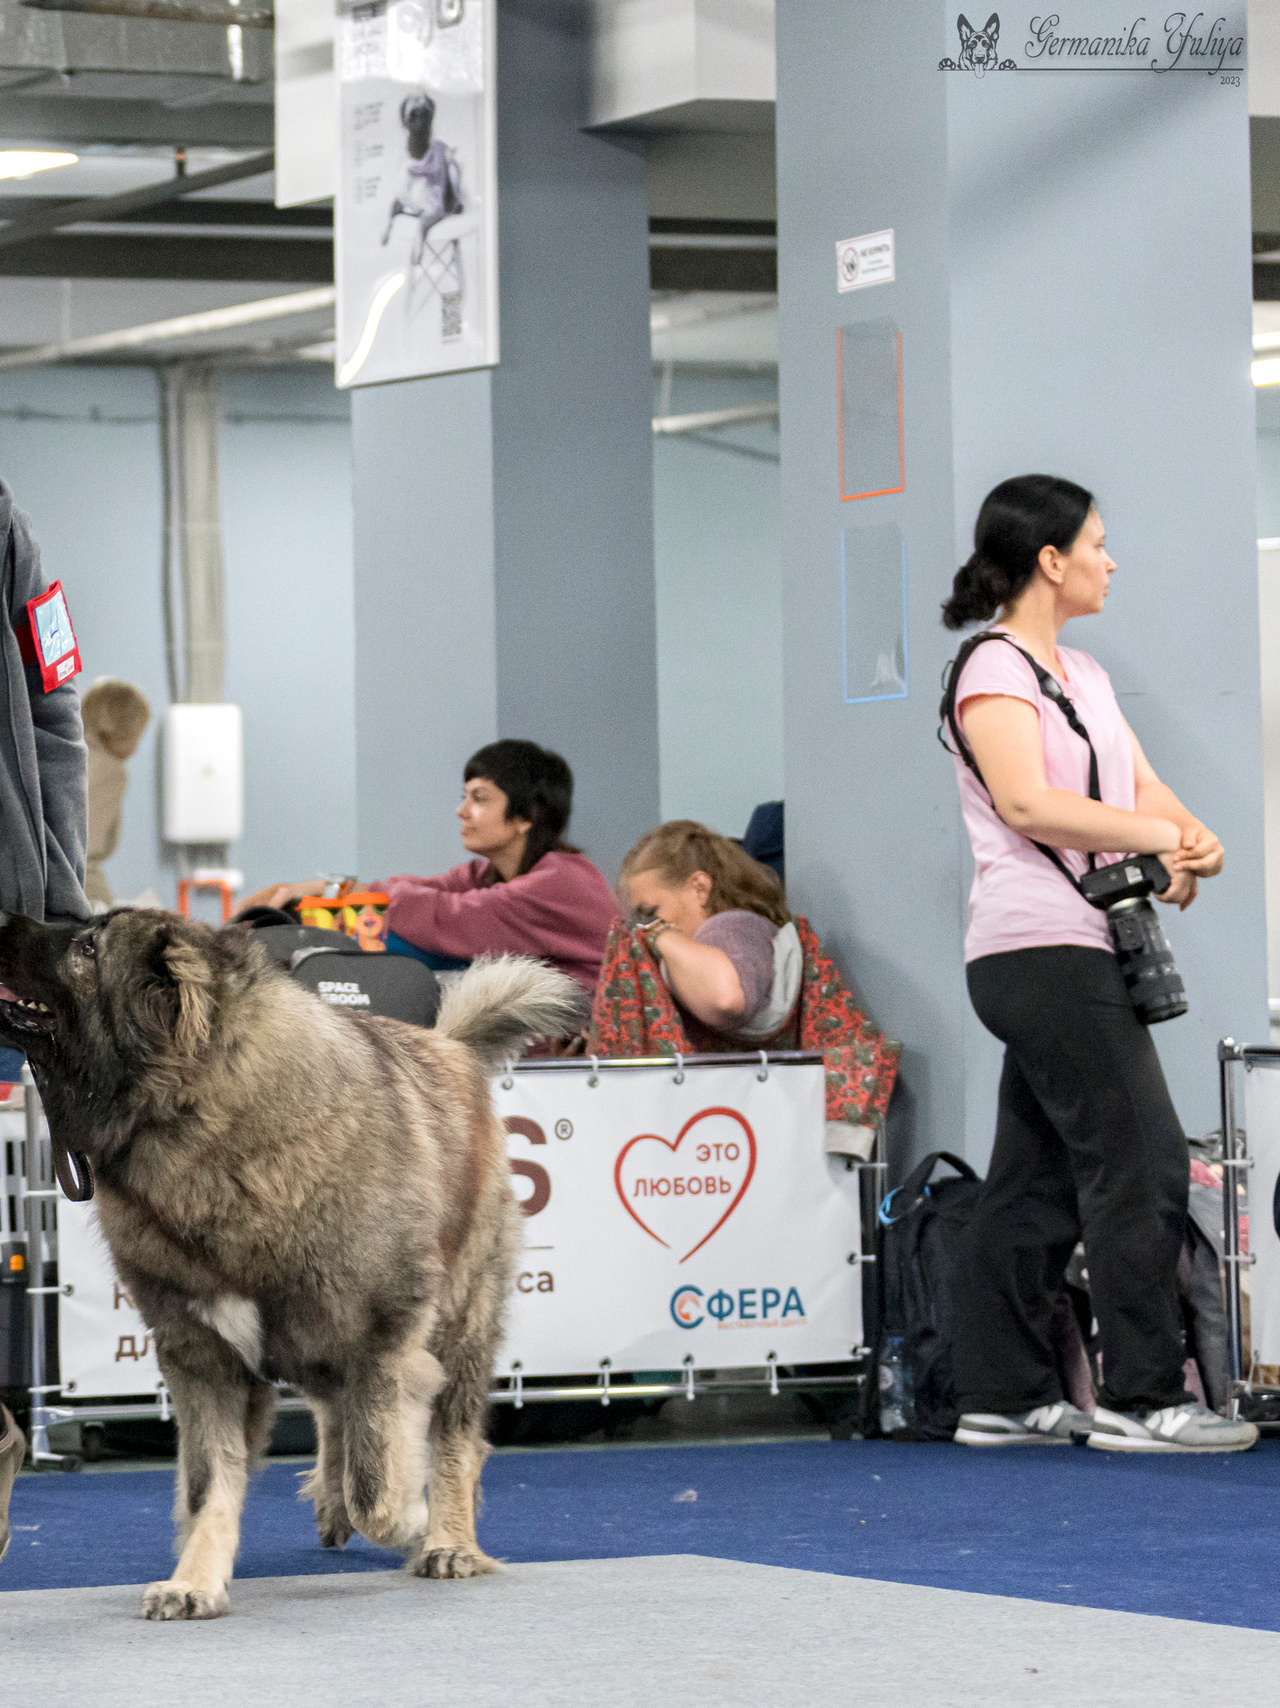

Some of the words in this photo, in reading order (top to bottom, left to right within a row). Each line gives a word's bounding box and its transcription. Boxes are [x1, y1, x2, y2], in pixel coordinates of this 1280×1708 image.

[317, 981, 360, 993] SPACE
[696, 1142, 740, 1163] ЭТО
[633, 1175, 732, 1198] ЛЮБОВЬ
[670, 1284, 806, 1330] СФЕРА
